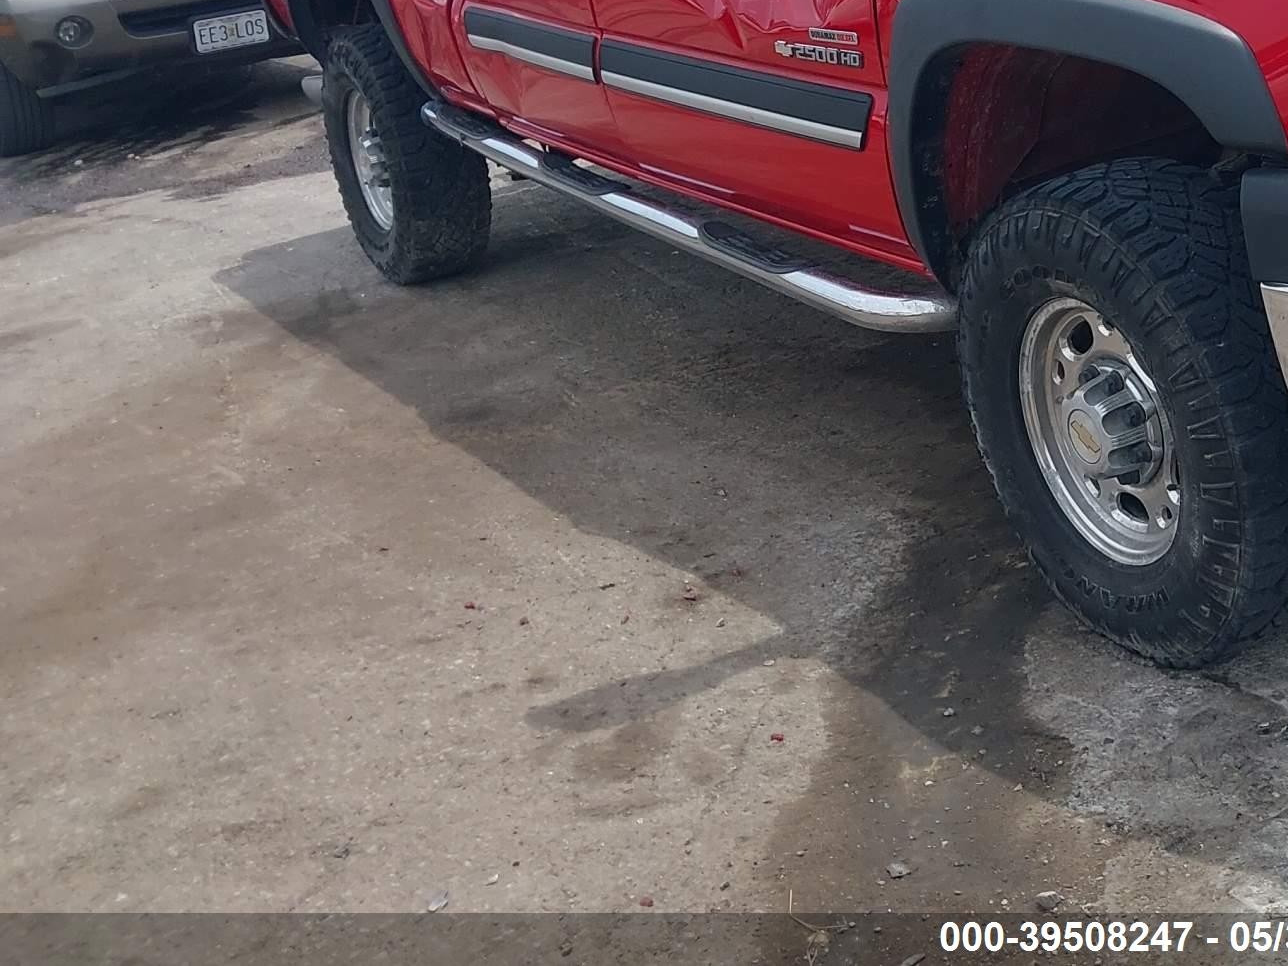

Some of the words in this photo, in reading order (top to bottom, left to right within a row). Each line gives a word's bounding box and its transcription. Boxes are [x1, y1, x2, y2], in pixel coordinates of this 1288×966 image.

[199, 25, 229, 46] EE3
[795, 44, 839, 65] 2500
[840, 51, 861, 67] HD
